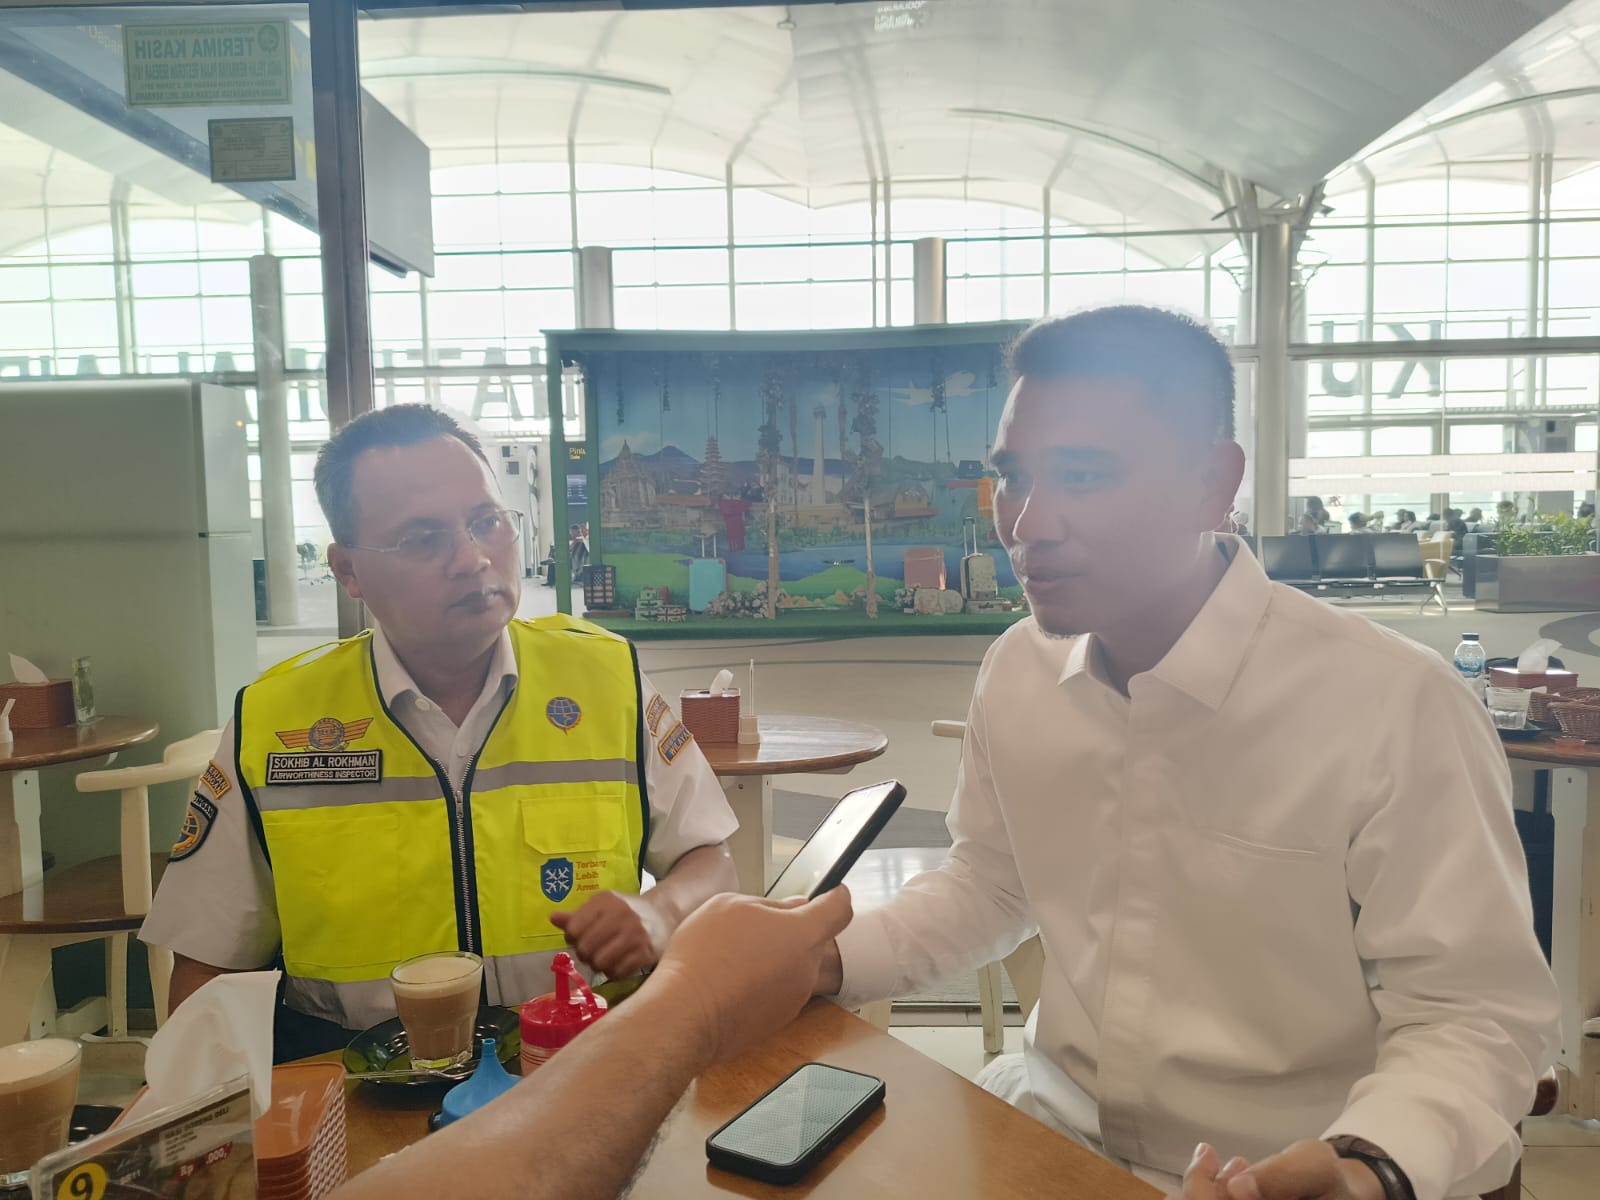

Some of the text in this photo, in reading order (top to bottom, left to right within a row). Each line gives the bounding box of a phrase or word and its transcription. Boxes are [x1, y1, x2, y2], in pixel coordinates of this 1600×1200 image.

[273, 755, 375, 769] SOKHIB AL ROKHMAN
[272, 770, 375, 780] AIRWORTHINESS INSPECTOR
[70, 1172, 93, 1200] 9
